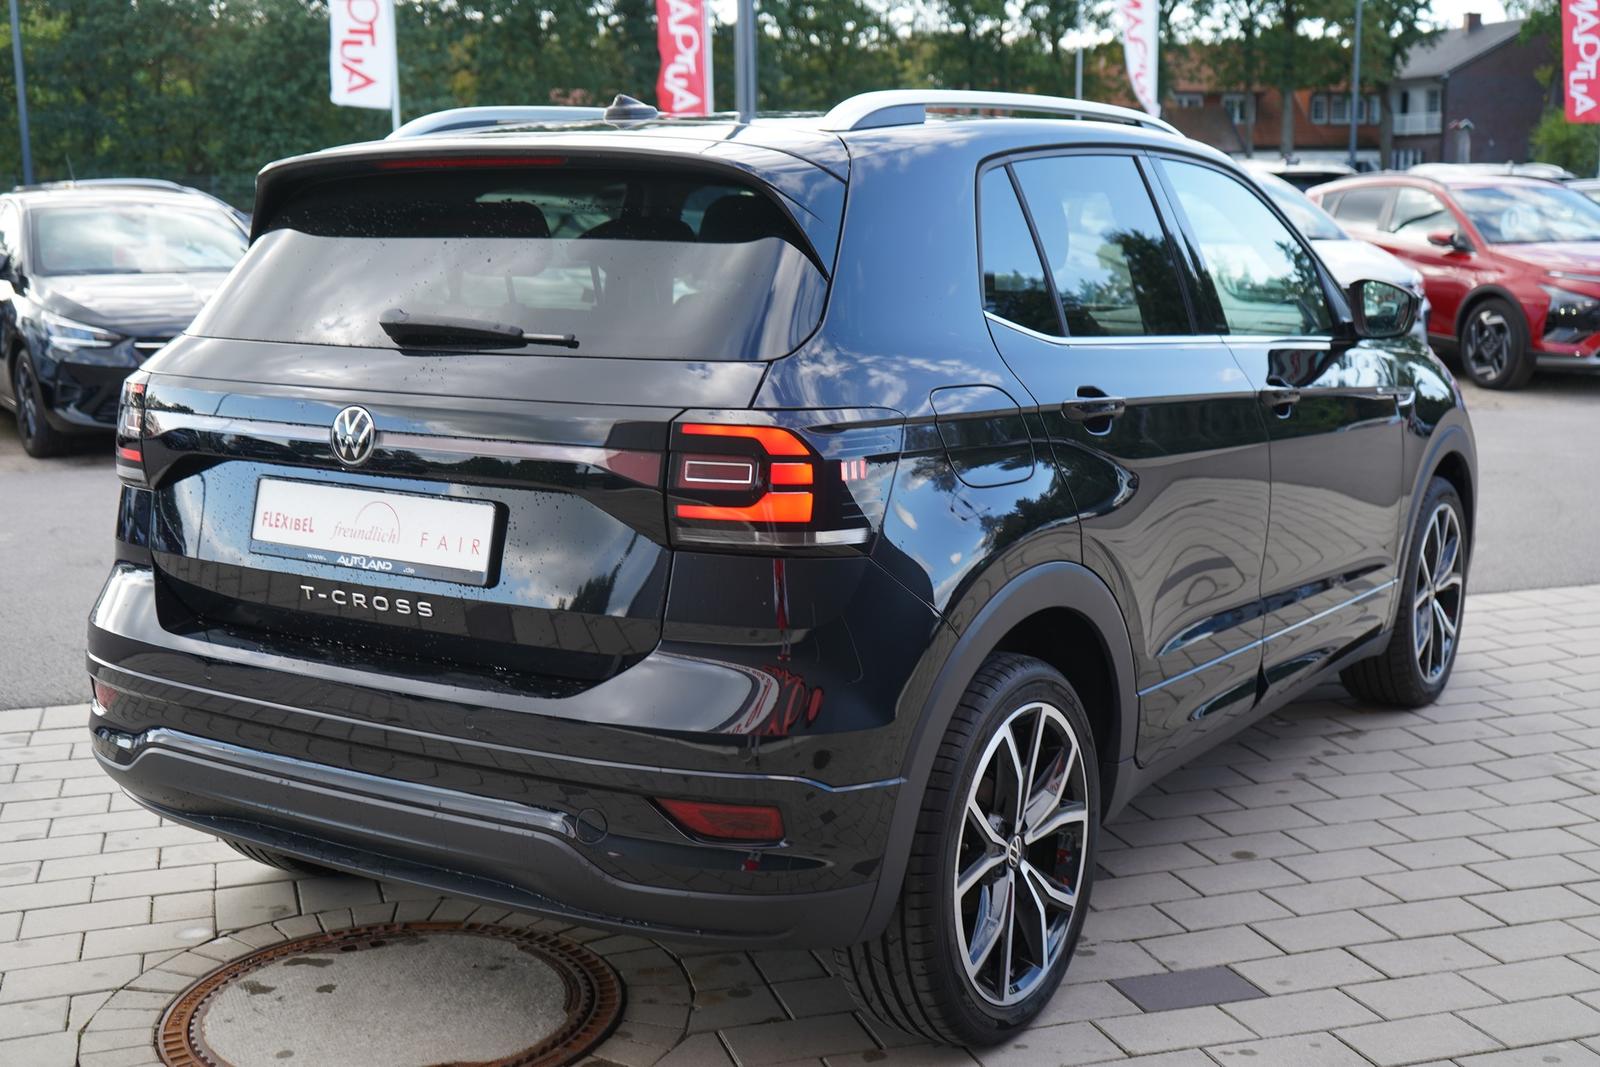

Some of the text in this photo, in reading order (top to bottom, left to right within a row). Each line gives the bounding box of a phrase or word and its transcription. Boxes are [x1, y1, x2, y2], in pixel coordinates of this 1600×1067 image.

[262, 511, 481, 555] FLEXIBEL freundlich FAIR
[337, 555, 393, 571] AUTOLAND
[300, 584, 434, 618] T-CROSS
